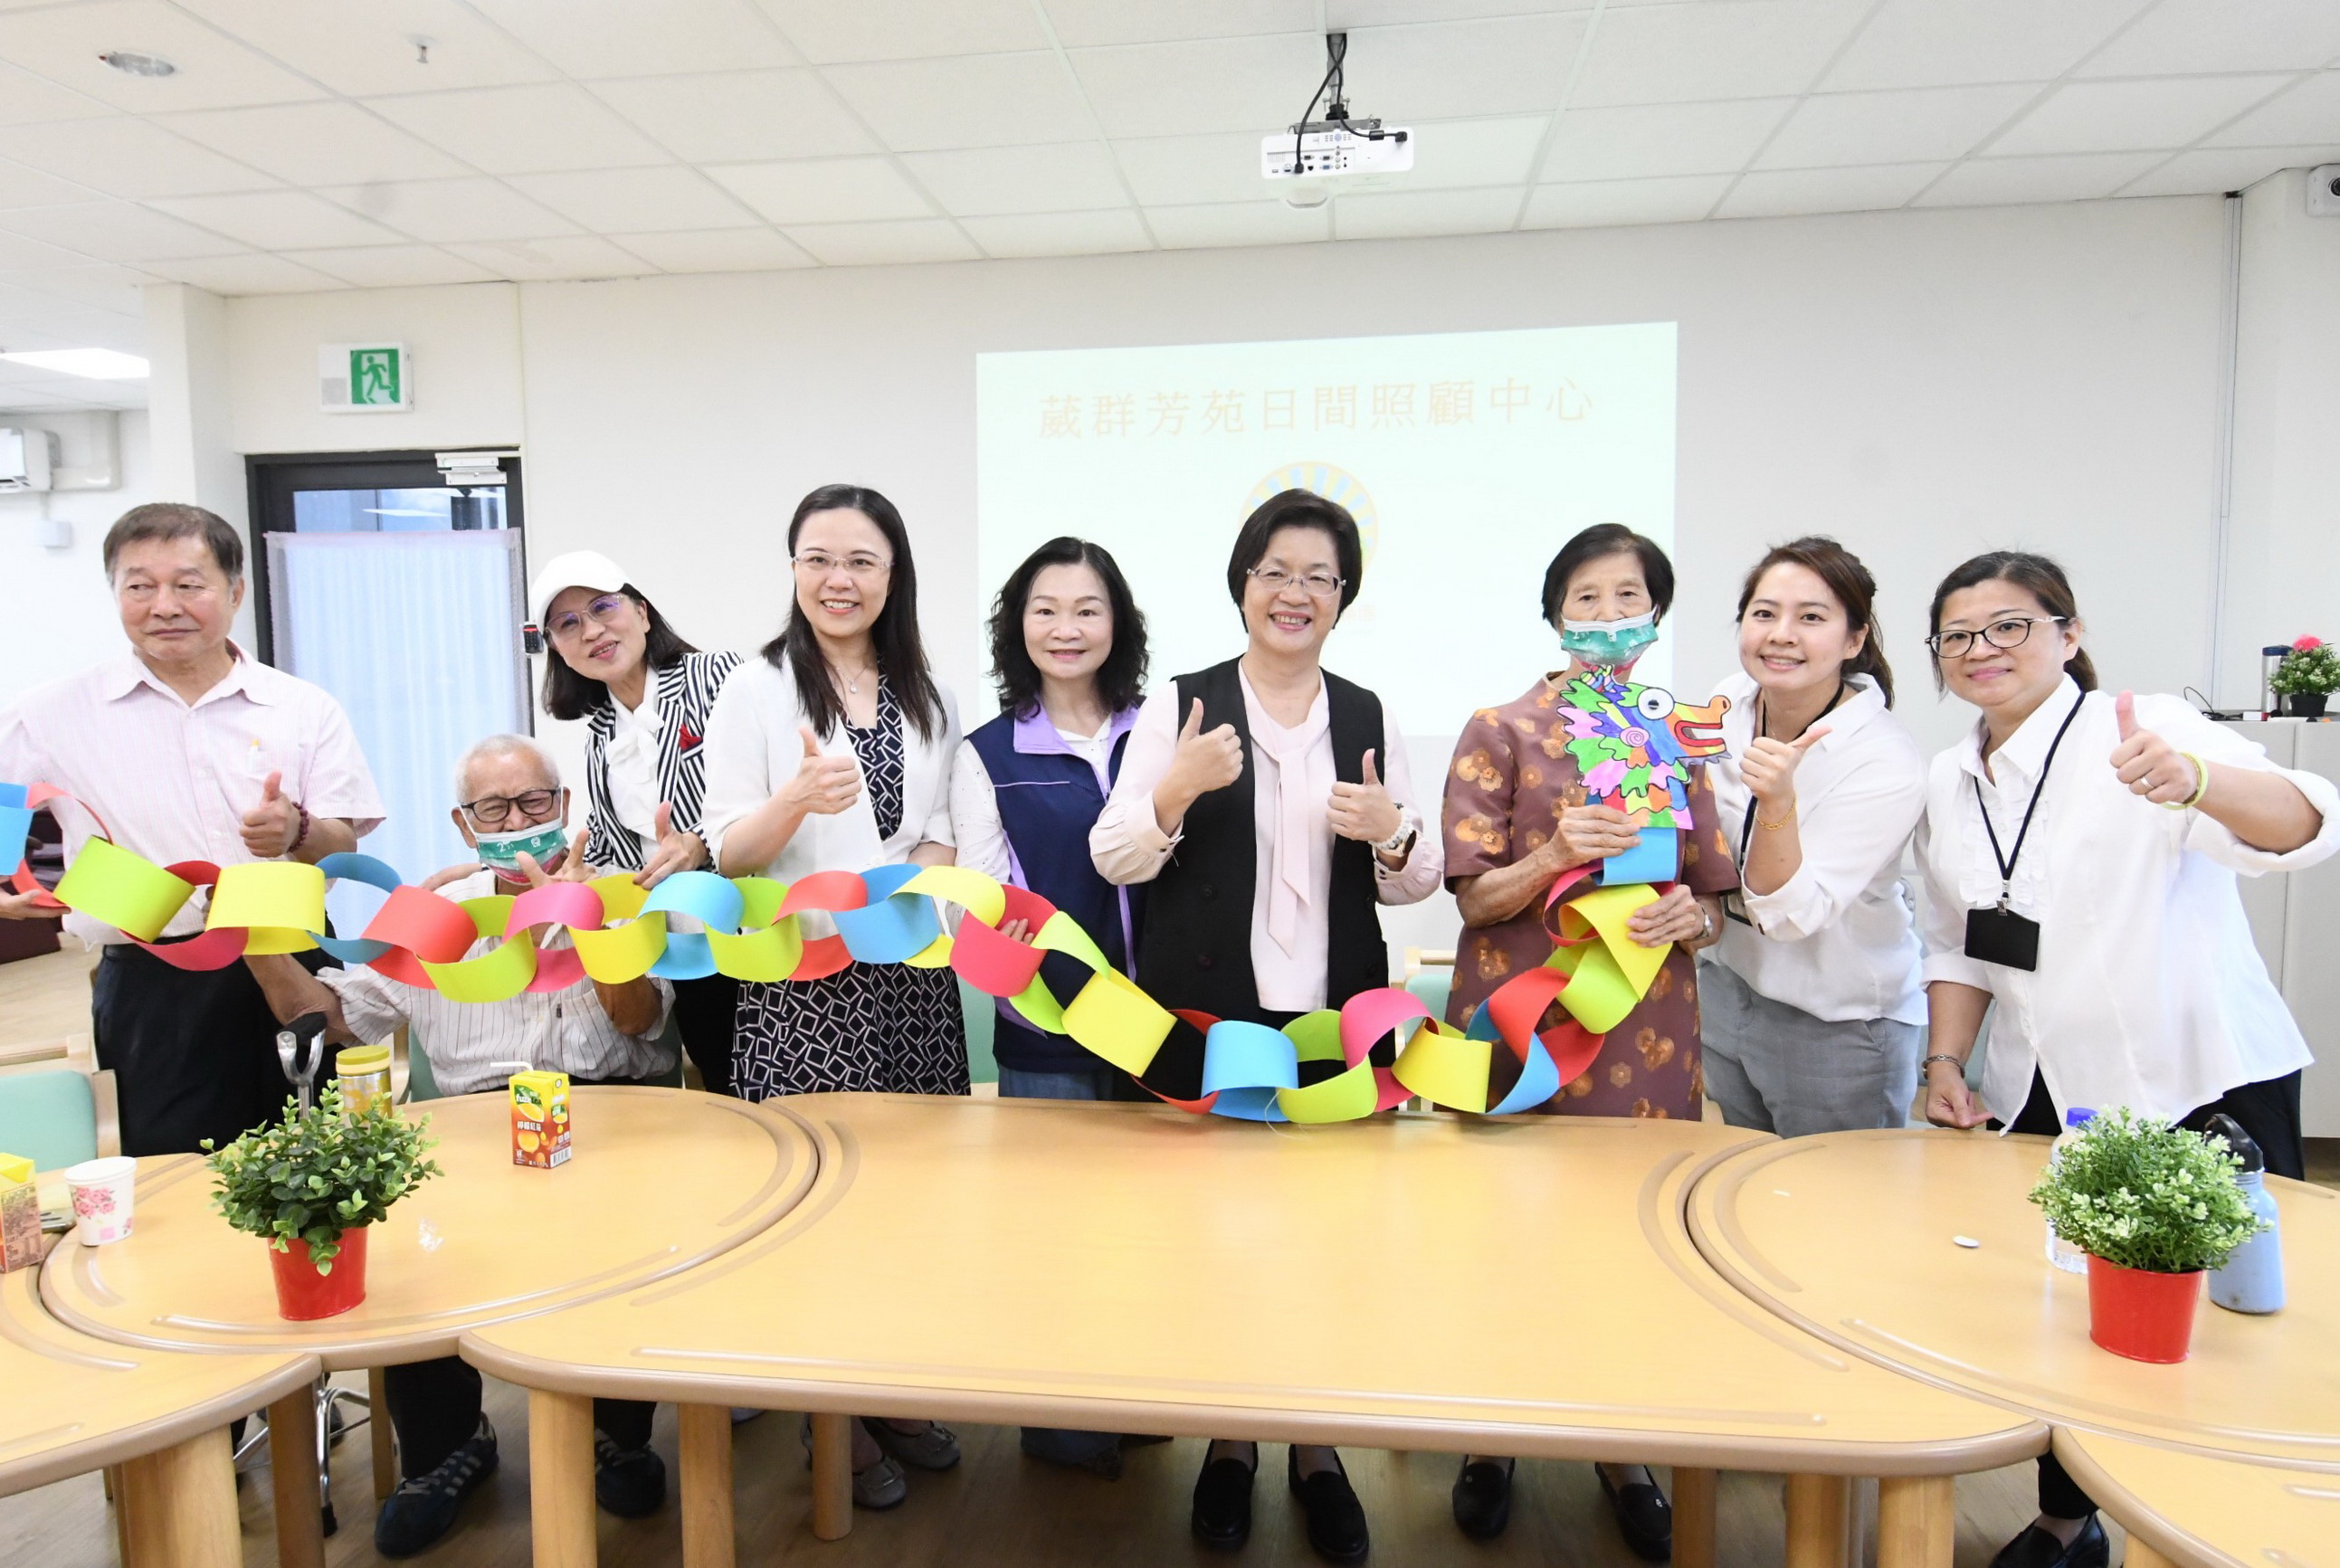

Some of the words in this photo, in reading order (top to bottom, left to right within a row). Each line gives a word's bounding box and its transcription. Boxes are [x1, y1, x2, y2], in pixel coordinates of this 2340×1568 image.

[1039, 377, 1593, 440] 葳群芳苑日間照顧中心
